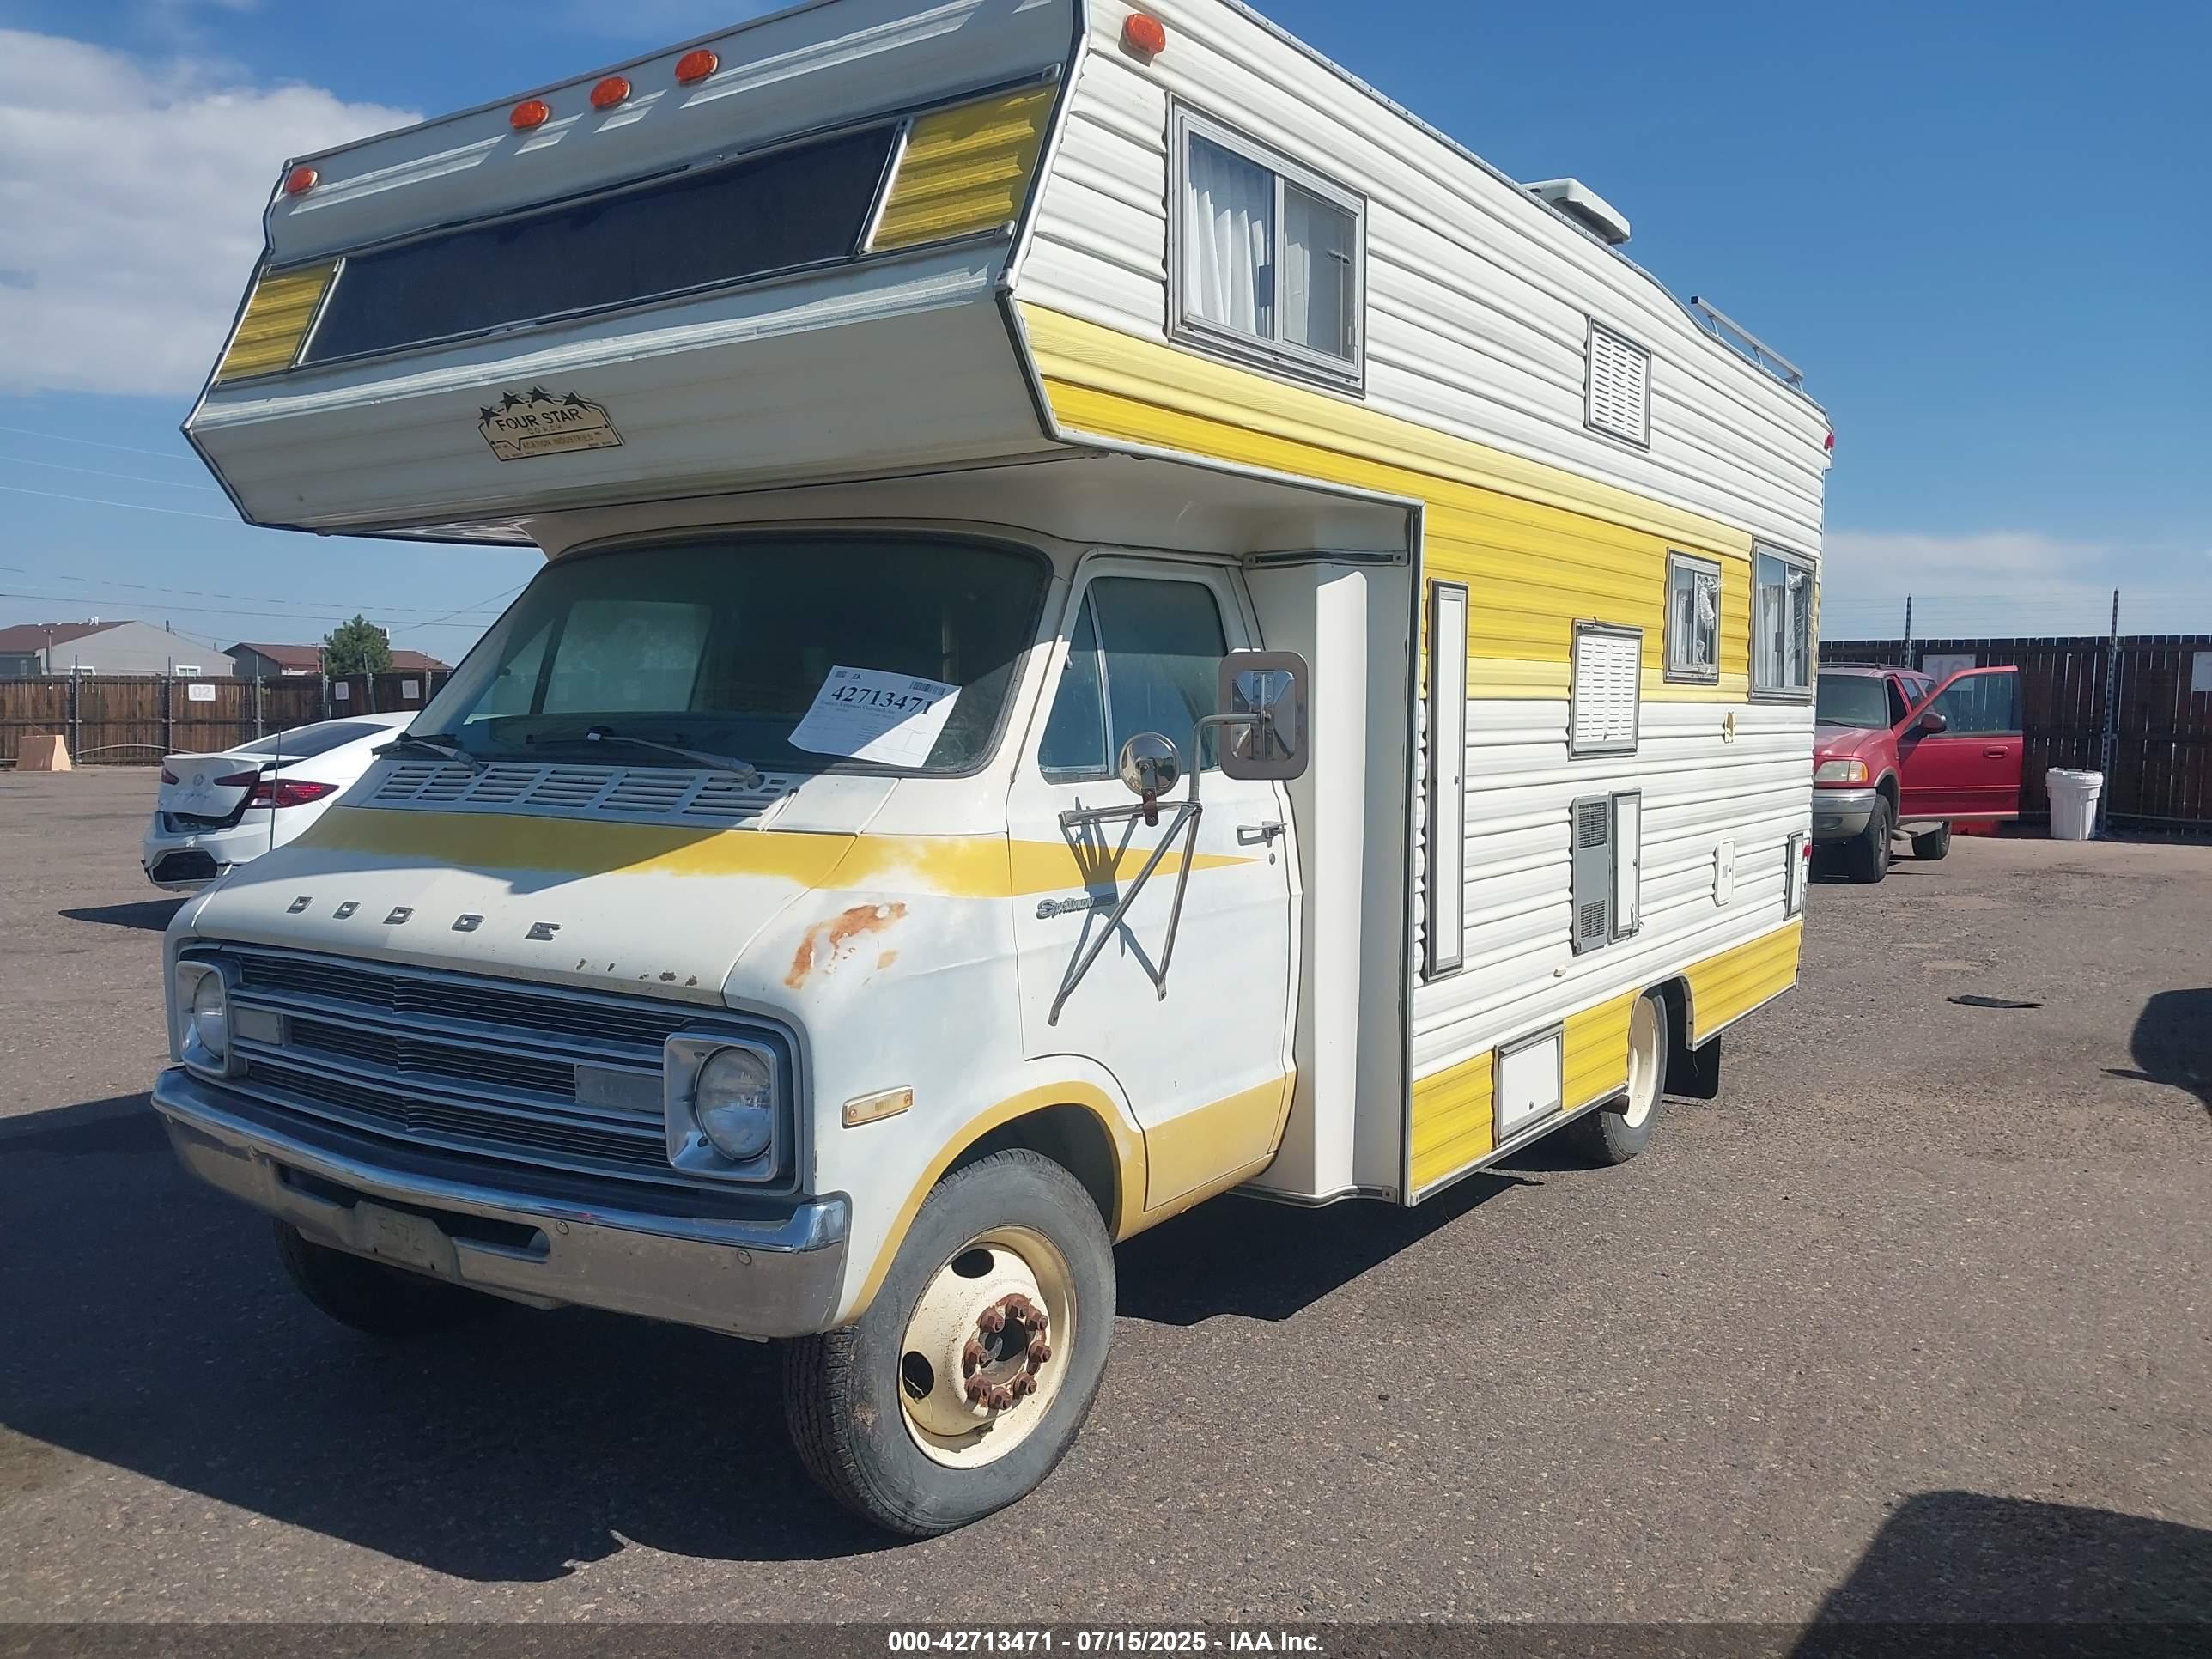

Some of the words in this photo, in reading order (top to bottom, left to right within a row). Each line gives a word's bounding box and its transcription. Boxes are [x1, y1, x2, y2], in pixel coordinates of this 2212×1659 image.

[495, 414, 539, 431] FOUR
[542, 408, 583, 424] STAR
[192, 685, 211, 698] 02
[831, 686, 933, 714] 42713471
[285, 895, 563, 941] DODGE
